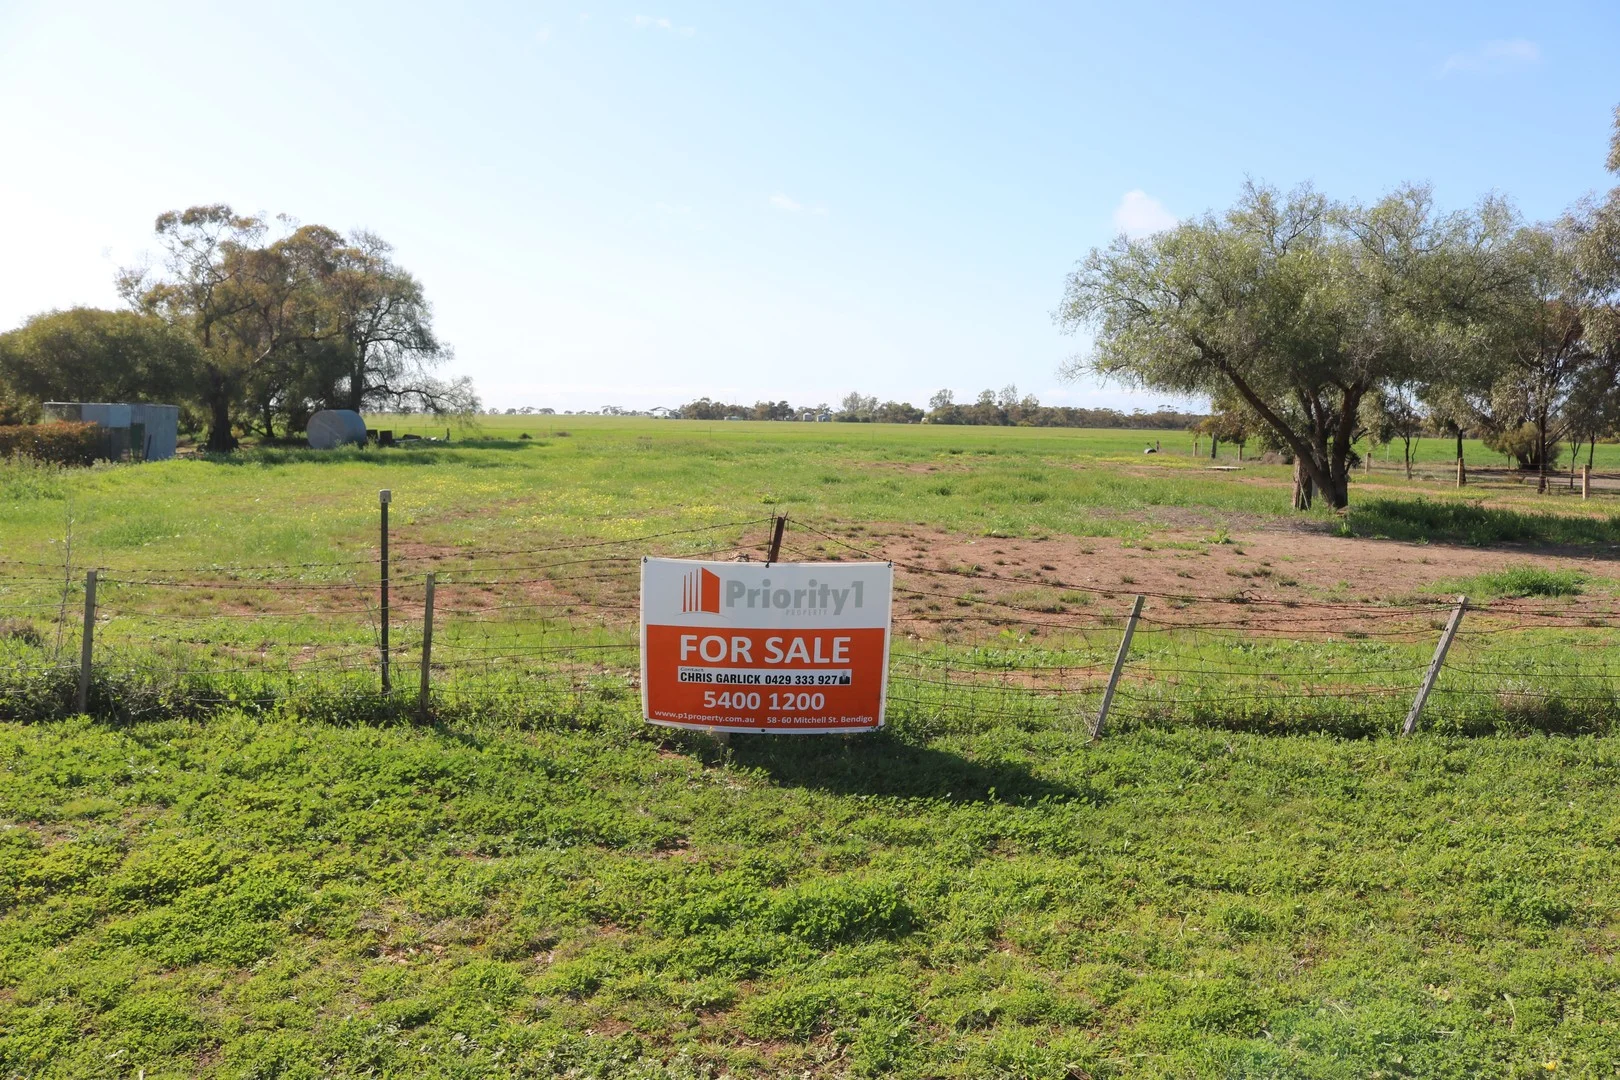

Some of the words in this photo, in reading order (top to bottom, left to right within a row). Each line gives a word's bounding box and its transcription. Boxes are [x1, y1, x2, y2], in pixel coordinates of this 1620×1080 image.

[726, 579, 863, 616] Priority1
[680, 634, 752, 663] FOR
[764, 636, 851, 664] SALE
[680, 672, 712, 683] CHRIS
[716, 673, 761, 684] GARLICK
[765, 675, 791, 685] 0429
[795, 675, 815, 685] 333
[818, 675, 838, 685] 927
[703, 691, 761, 709] 5400
[769, 693, 825, 711] 1200
[654, 709, 755, 723] www.p1property.com.au
[766, 716, 792, 724] 58-60
[794, 716, 826, 724] Mitchell
[841, 715, 873, 724] Bendigo
